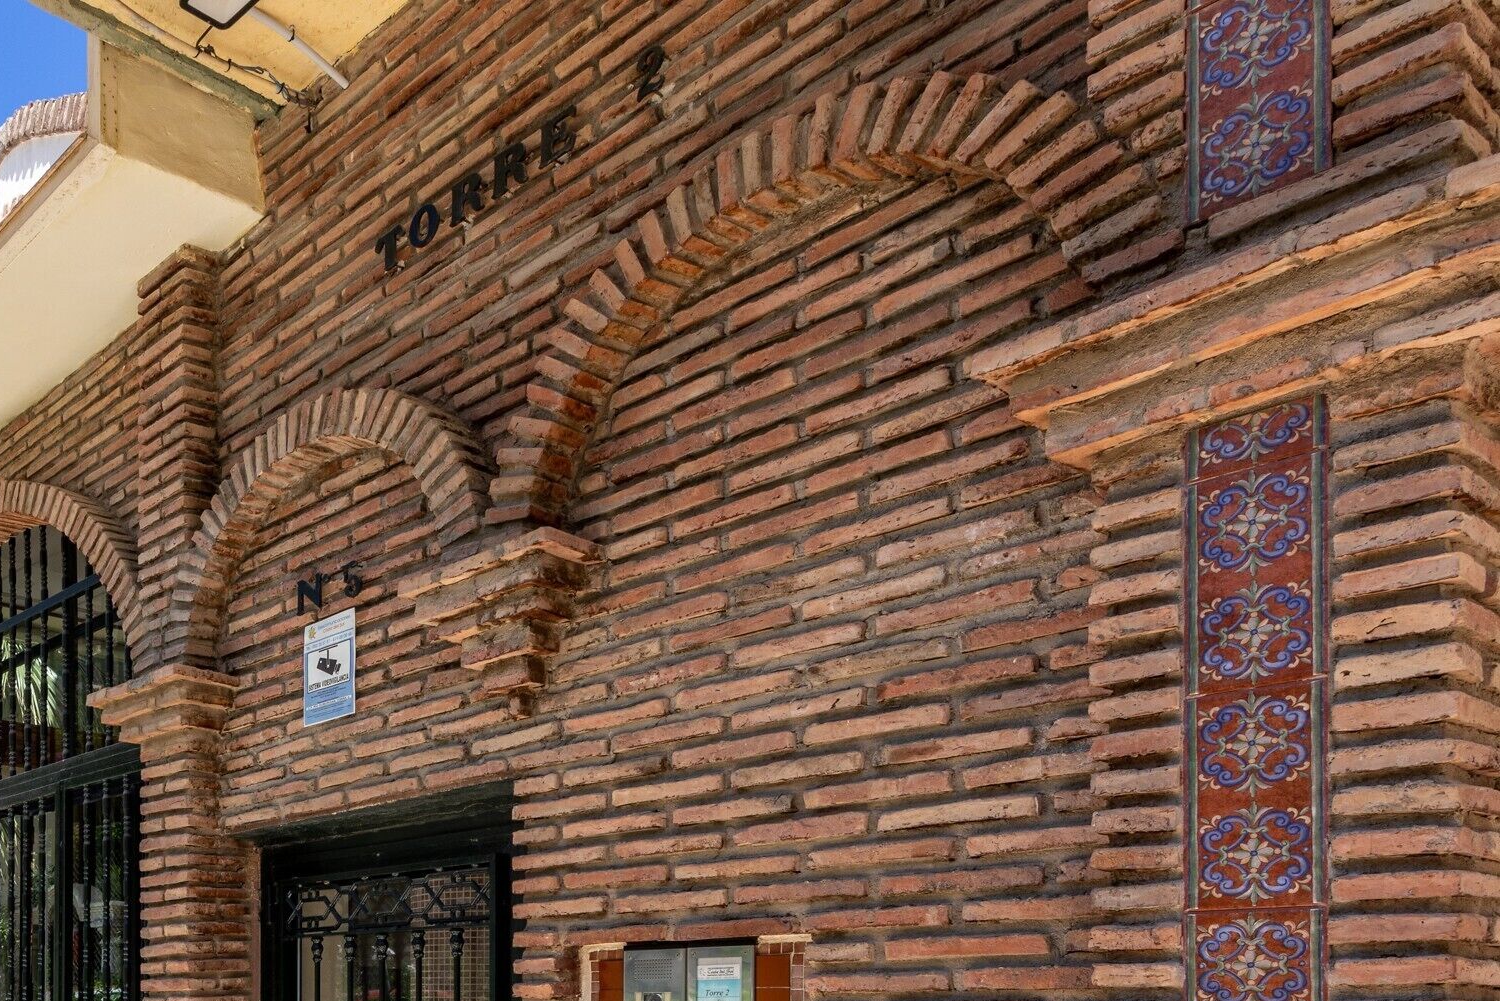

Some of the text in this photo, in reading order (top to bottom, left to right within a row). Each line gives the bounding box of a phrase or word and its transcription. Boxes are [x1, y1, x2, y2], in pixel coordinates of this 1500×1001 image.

[375, 45, 666, 271] TORRE 2
[340, 560, 363, 598] 5
